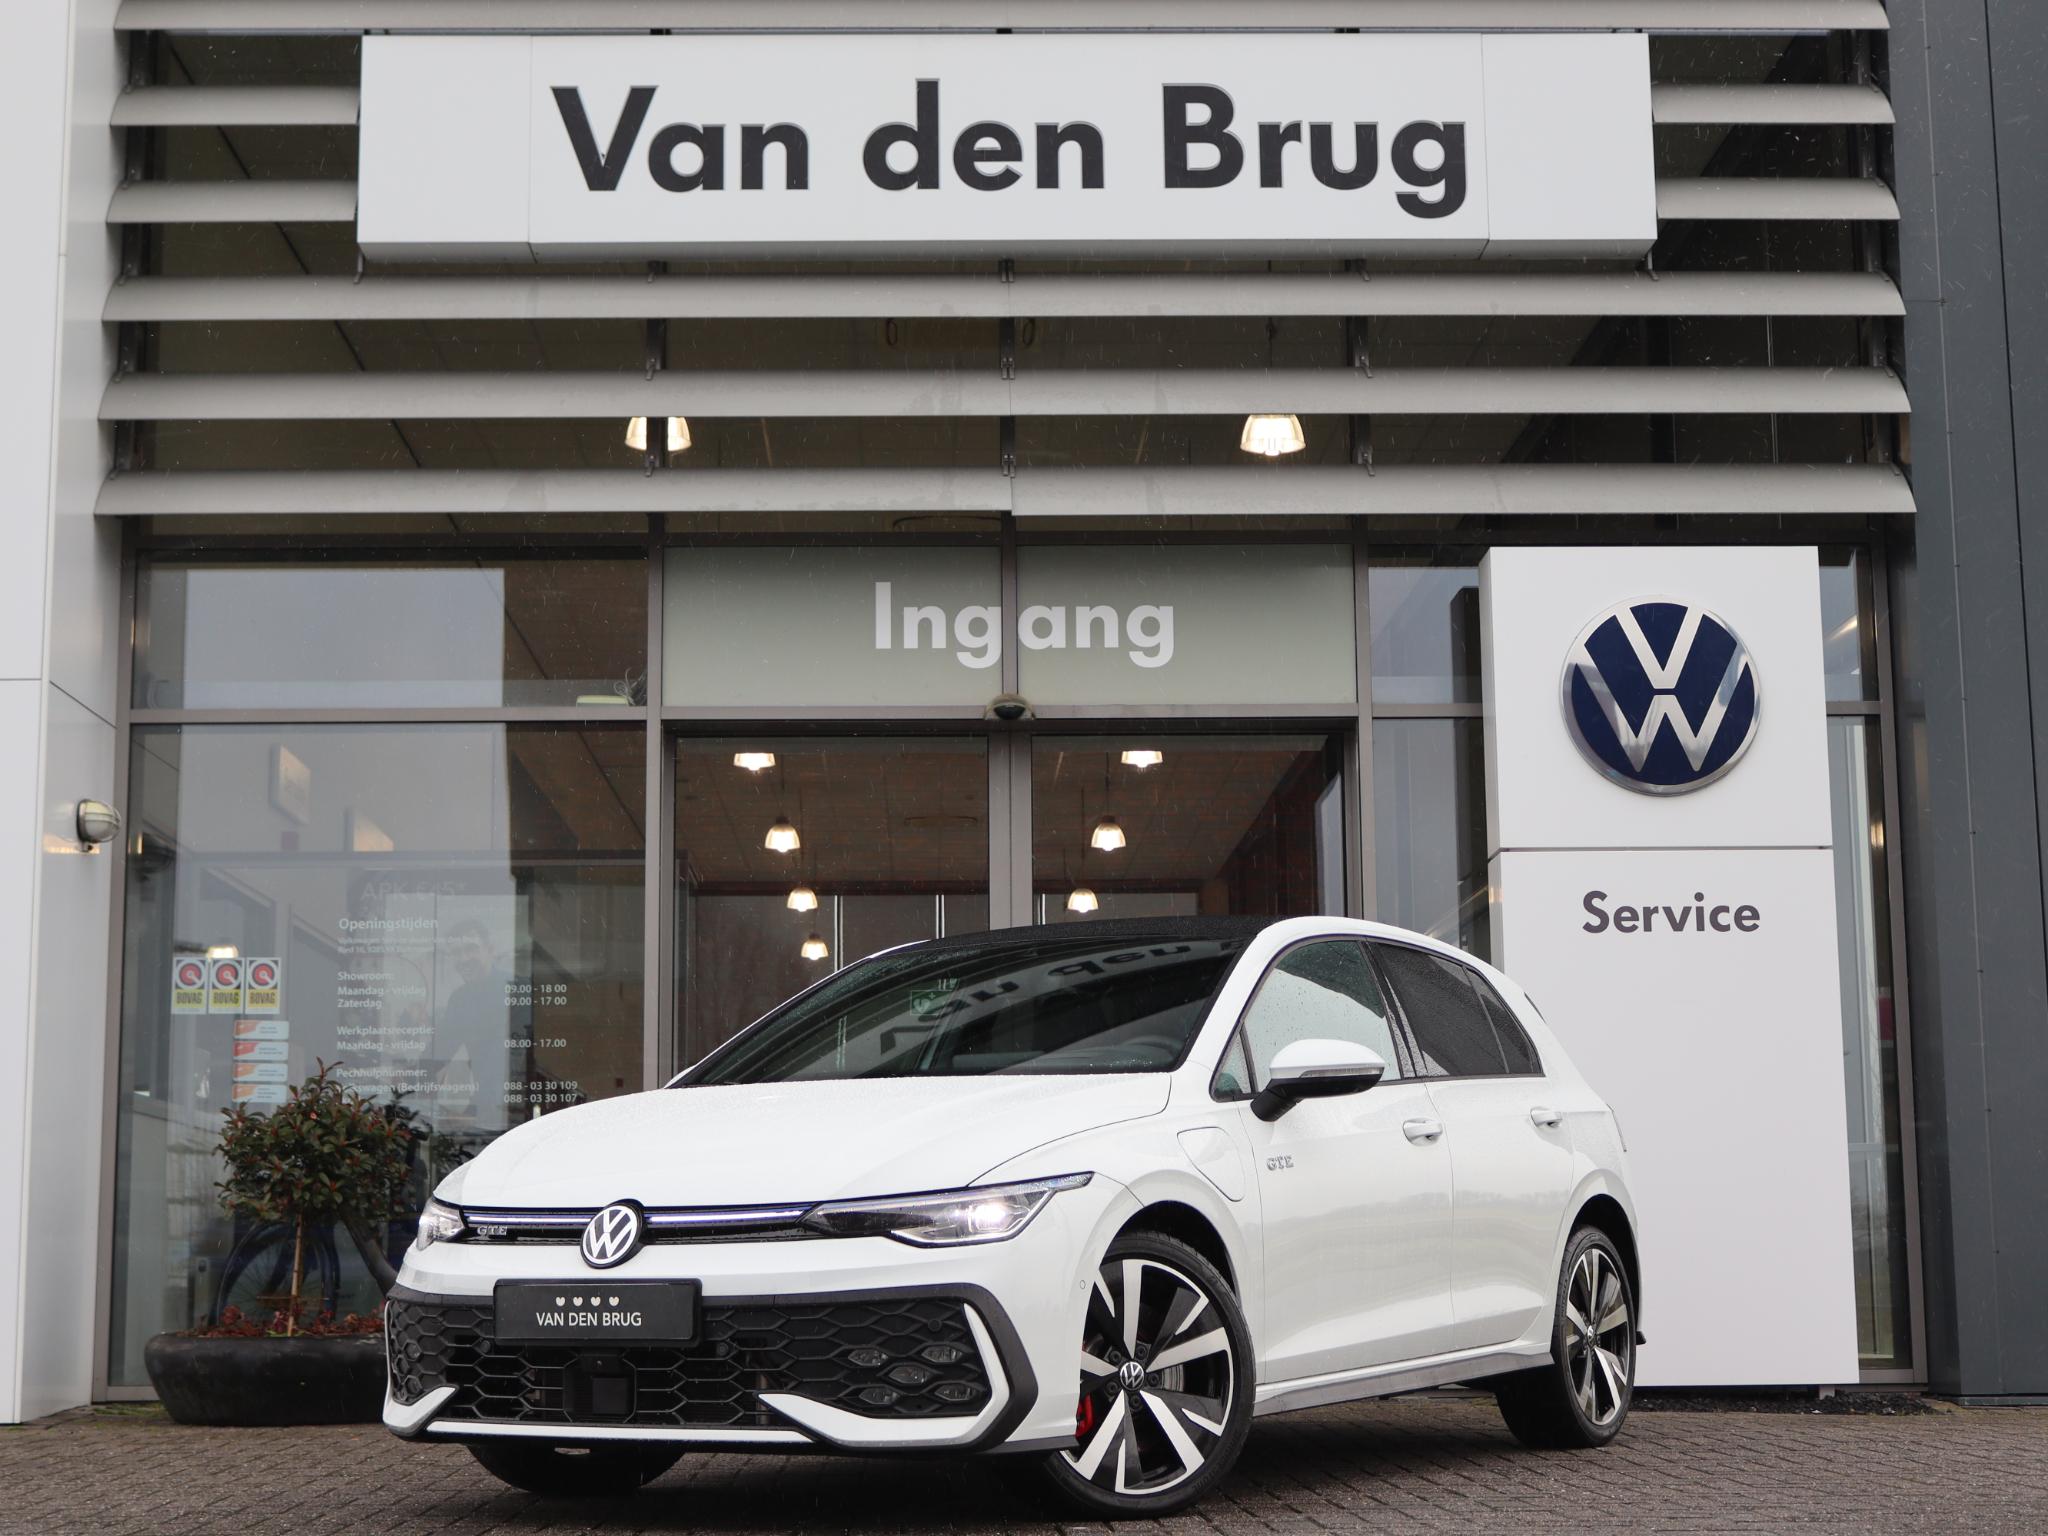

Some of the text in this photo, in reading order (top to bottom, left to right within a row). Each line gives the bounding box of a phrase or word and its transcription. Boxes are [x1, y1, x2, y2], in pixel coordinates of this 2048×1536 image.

[550, 78, 1467, 219] Van den Brug
[875, 581, 1175, 669] Ingang
[1582, 890, 1760, 934] Service
[338, 917, 438, 931] Openingstijden
[337, 986, 384, 997] Maandag
[392, 985, 426, 997] vrijdag
[504, 984, 532, 993] 09.00
[337, 998, 383, 1009] Zaterdag
[504, 997, 532, 1006] 09.00
[336, 1025, 436, 1037] Werkplaatsreceptie:
[336, 1041, 384, 1051] Maandag
[391, 1041, 426, 1051] vrijdag
[504, 1039, 532, 1048] 08.00
[540, 1039, 567, 1048] 17.00
[336, 1068, 428, 1079] Pechhulpnummer:
[503, 1081, 522, 1090] 088
[530, 1081, 543, 1090] 03
[545, 1081, 557, 1090] 30
[560, 1081, 578, 1090] 109
[503, 1094, 522, 1103] 088
[530, 1094, 543, 1103] 03
[545, 1094, 557, 1103] 30
[560, 1094, 577, 1103] 107
[1266, 1155, 1294, 1171] GTE
[476, 1225, 508, 1236] GTE
[536, 1312, 642, 1327] VAN DEN BRUG
